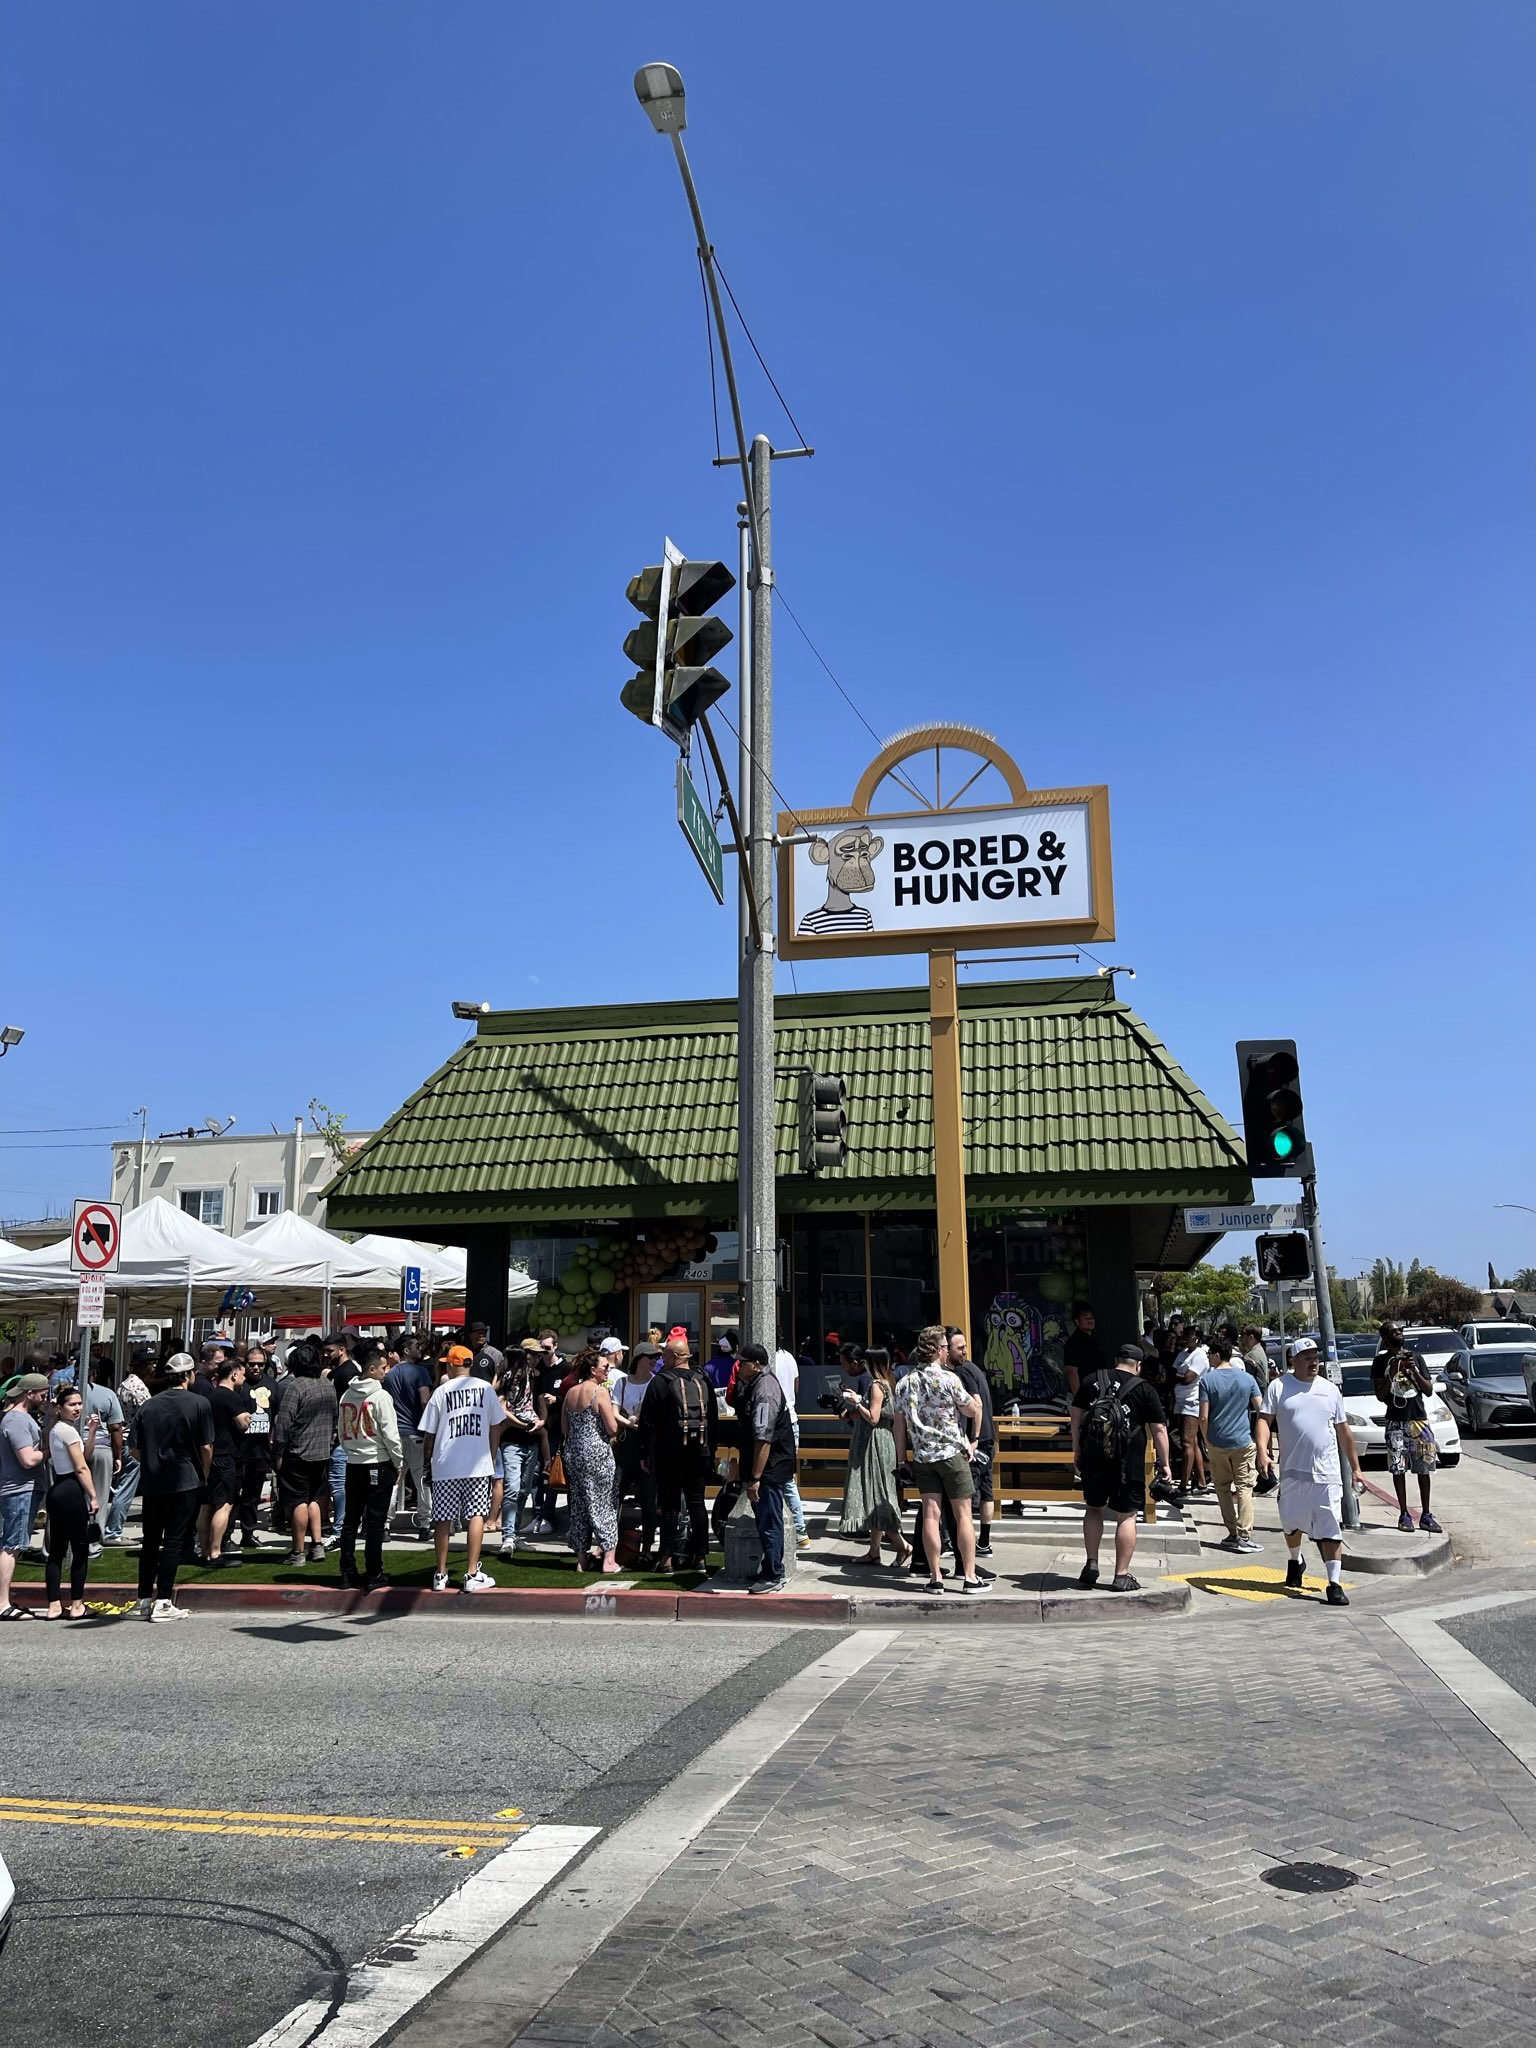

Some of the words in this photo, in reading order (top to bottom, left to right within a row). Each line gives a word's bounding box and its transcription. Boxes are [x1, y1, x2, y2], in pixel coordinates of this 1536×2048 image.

[893, 834, 1030, 873] BORED
[1037, 830, 1066, 862] &
[894, 865, 1068, 907] HUNGRY
[1218, 1211, 1274, 1228] Junipero
[684, 1270, 708, 1278] 2405
[445, 1387, 485, 1413] NINETY
[449, 1413, 482, 1439] THREE
